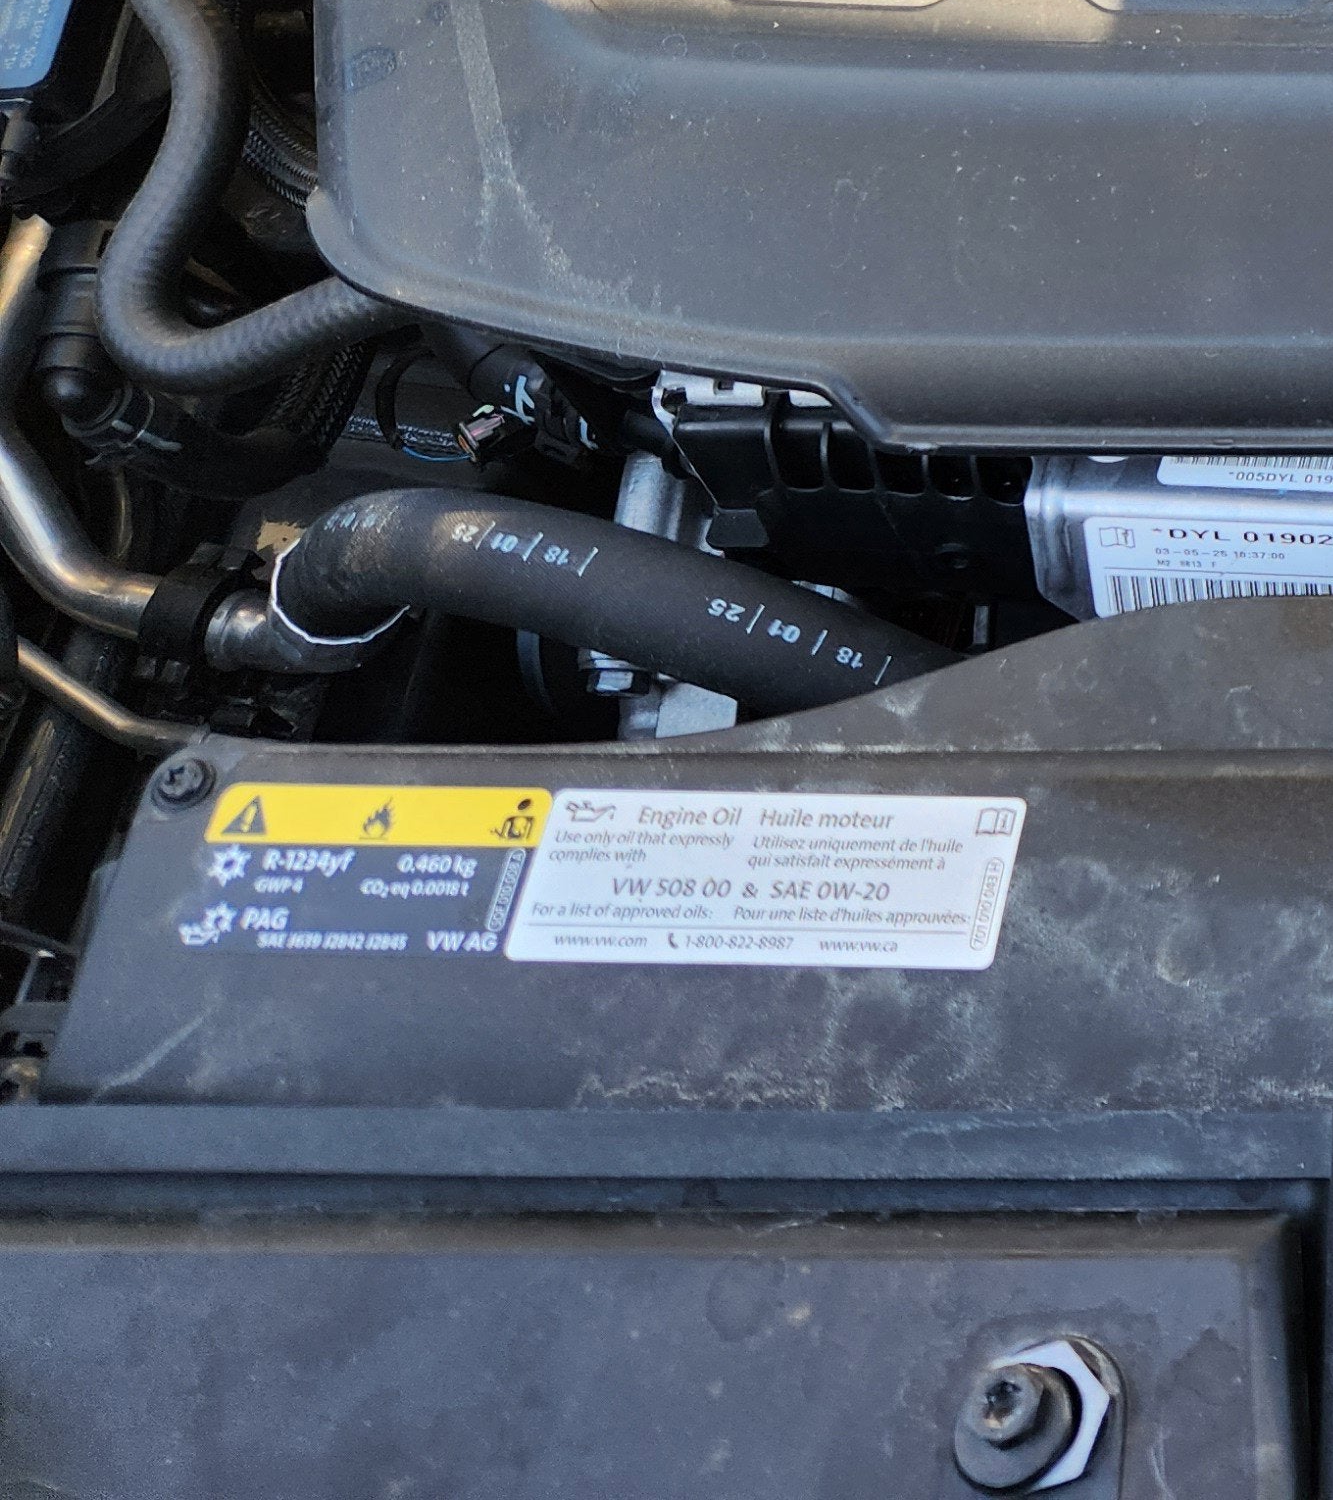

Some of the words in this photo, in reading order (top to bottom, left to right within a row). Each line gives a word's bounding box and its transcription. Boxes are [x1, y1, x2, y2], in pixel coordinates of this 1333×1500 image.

[707, 598, 745, 622] 25
[767, 619, 800, 643] 01
[835, 646, 864, 669] 18
[638, 806, 707, 830] Engine
[713, 807, 742, 825] Oil
[759, 808, 812, 828] Huile
[818, 811, 894, 829] moteur
[555, 830, 583, 844] Use
[584, 831, 615, 848] only
[617, 831, 635, 845] oil
[636, 832, 667, 845] that
[669, 832, 734, 849] expressly
[753, 836, 805, 850] Utilisez
[809, 837, 895, 856] uniquement
[899, 838, 917, 852] de
[920, 838, 963, 854] l'huile
[261, 849, 355, 877] R-1234yf
[399, 854, 450, 873] 0.460
[452, 856, 477, 878] kg
[549, 848, 612, 865] complies
[614, 848, 646, 862] with
[748, 854, 771, 868] qui
[774, 853, 830, 869] satisfait
[834, 855, 932, 873] expressément
[937, 857, 945, 870] à
[254, 877, 290, 893] GWP
[612, 877, 652, 896] VW
[655, 878, 696, 898] 508
[702, 879, 732, 898] 00
[742, 882, 758, 898] &
[770, 880, 811, 900] SAE
[817, 882, 890, 901] 0W-20
[241, 906, 289, 930] PAG
[532, 903, 555, 916] For
[557, 907, 566, 916] a
[569, 903, 591, 917] list
[593, 903, 610, 920] of
[612, 903, 680, 922] approved
[683, 905, 713, 920] oils:
[733, 906, 767, 920] Pour
[769, 909, 795, 921] une
[799, 906, 828, 922] liste
[830, 906, 882, 923] d'huiles
[885, 907, 971, 927] approuvées:
[426, 931, 463, 950] VW
[464, 932, 498, 951] AG
[554, 935, 647, 948] www.vw.com
[684, 934, 794, 951] 1-800-822-8987
[819, 940, 898, 953] www.vw.ca
